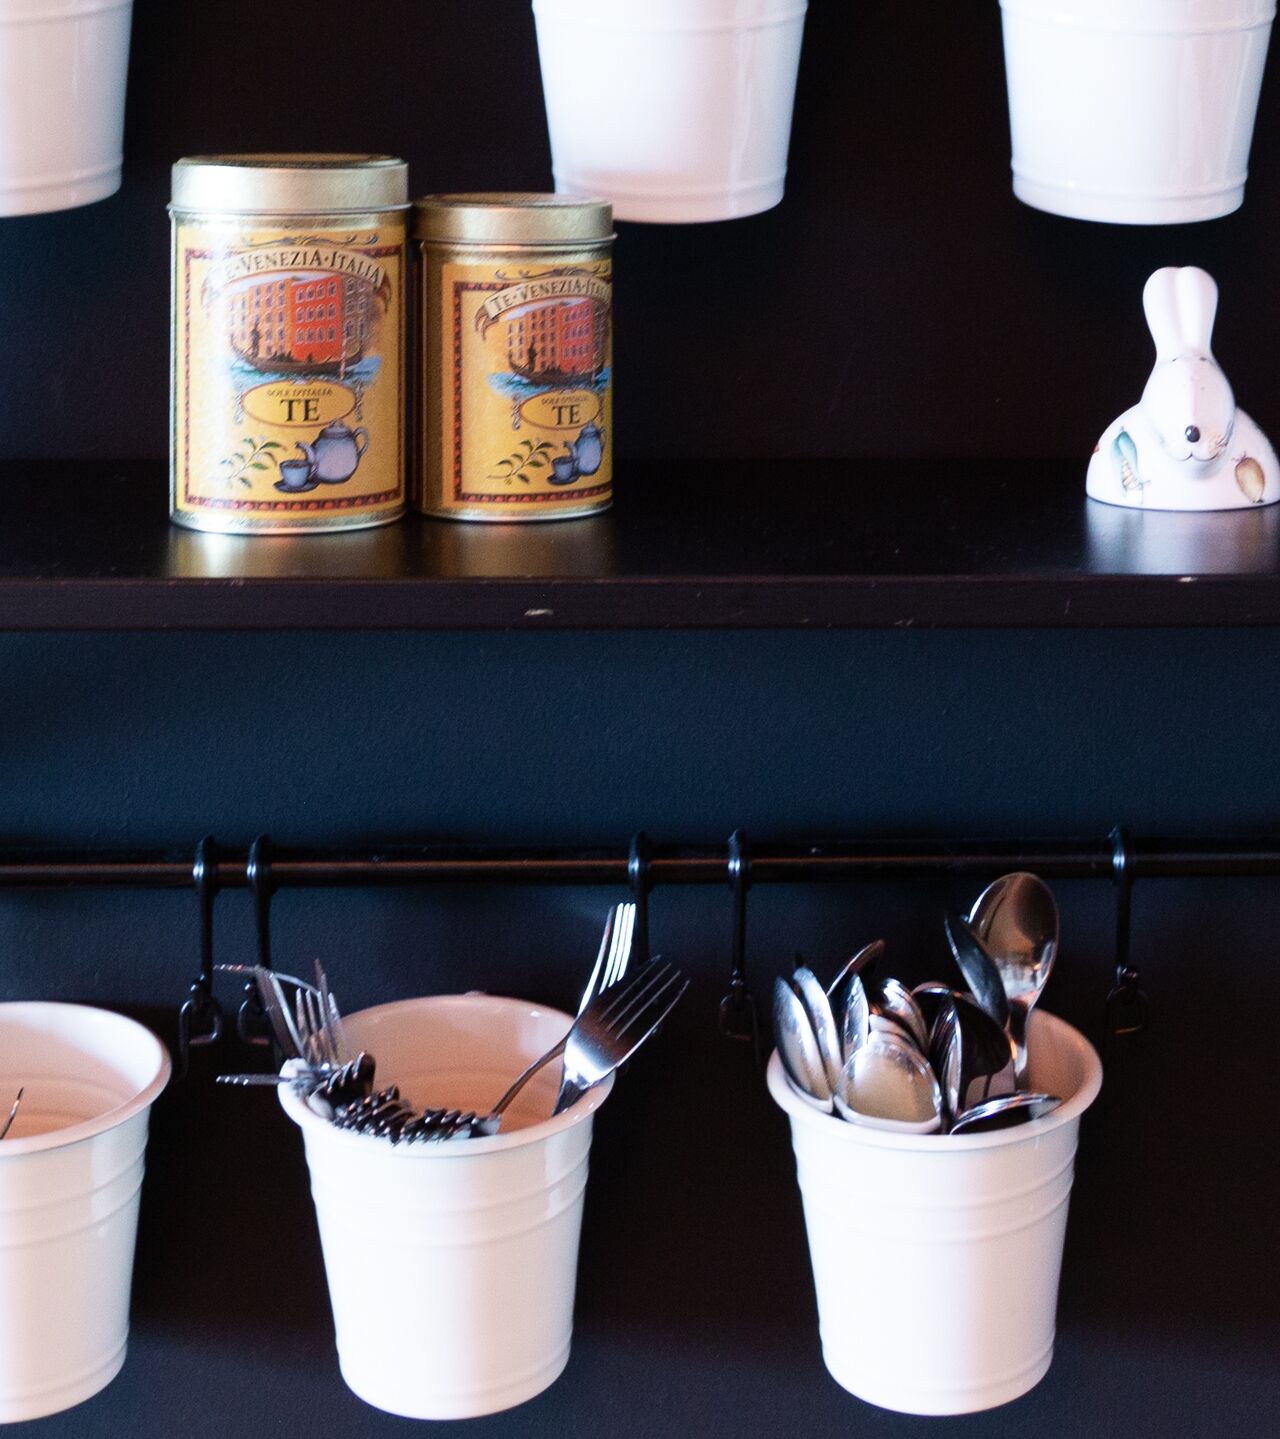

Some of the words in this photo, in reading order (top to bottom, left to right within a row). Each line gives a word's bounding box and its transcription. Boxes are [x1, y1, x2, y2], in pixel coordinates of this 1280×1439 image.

[240, 248, 322, 273] VENEZIA
[329, 250, 384, 286] ITALIA
[489, 292, 514, 312] TE
[517, 278, 583, 301] VENEZIA
[280, 398, 320, 422] TE
[552, 404, 581, 425] TE
